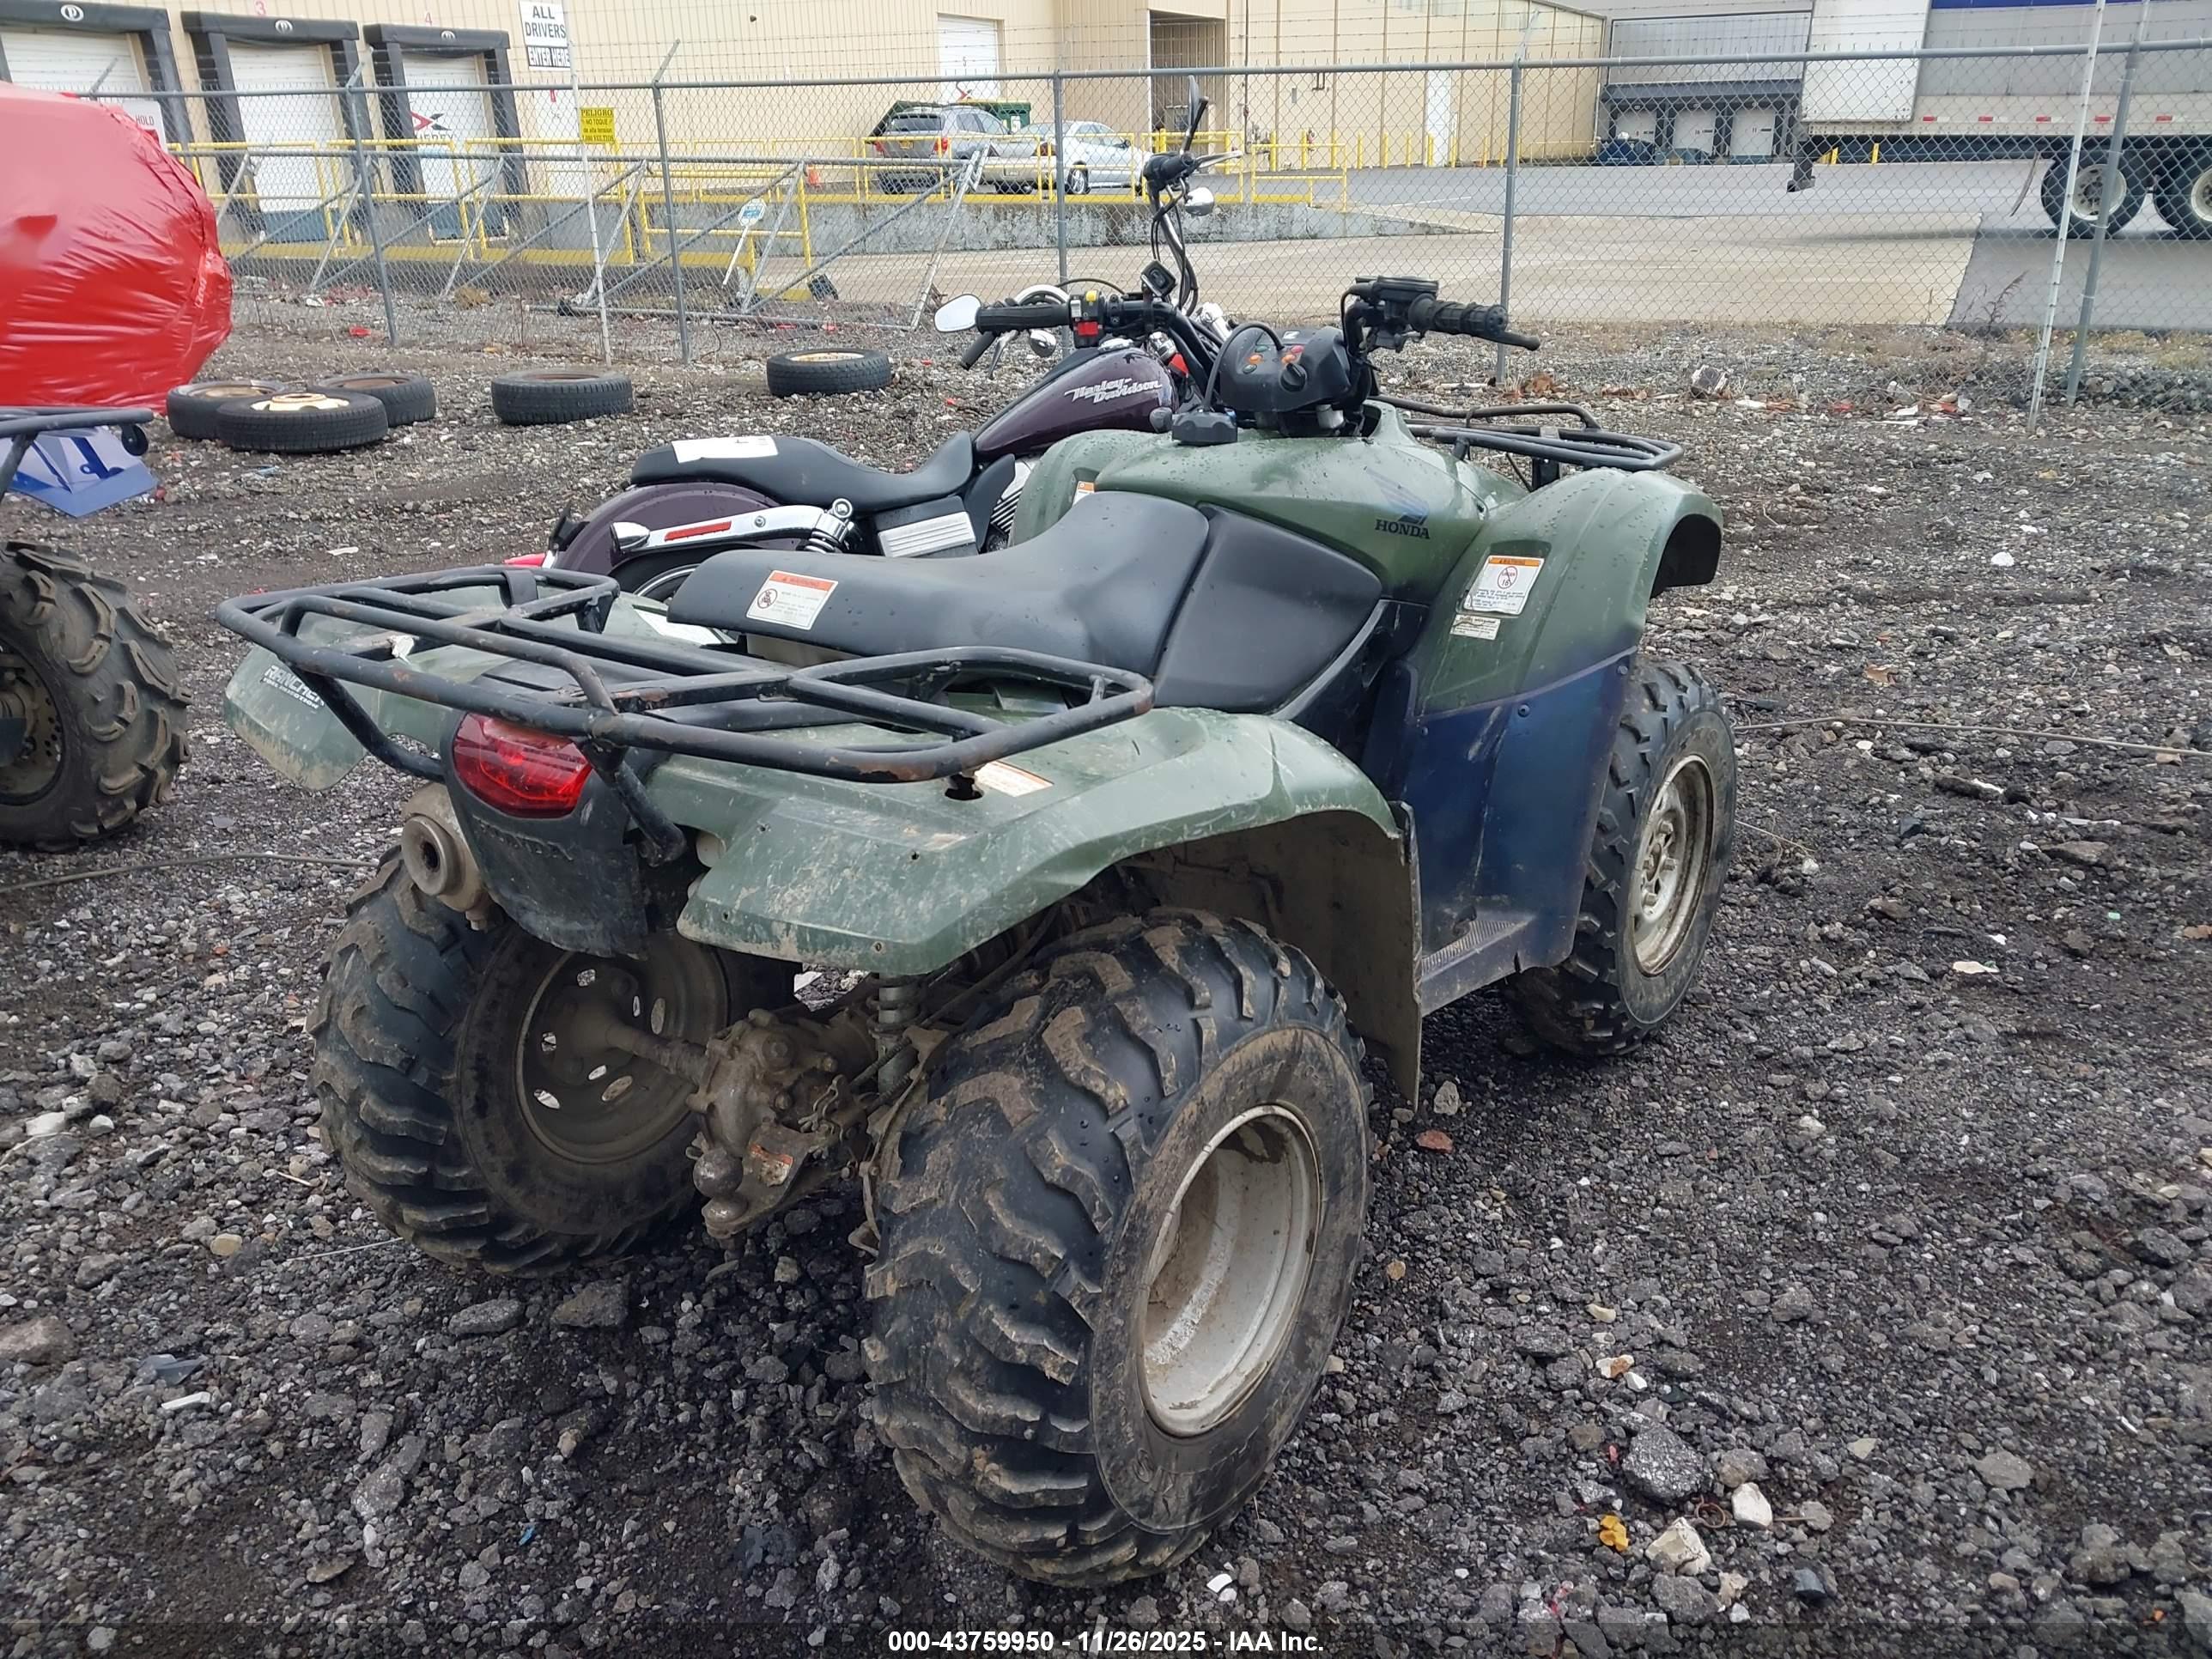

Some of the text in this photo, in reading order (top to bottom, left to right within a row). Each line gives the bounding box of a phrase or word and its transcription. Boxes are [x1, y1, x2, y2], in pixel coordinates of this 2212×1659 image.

[532, 5, 556, 20] ALL
[525, 21, 567, 39] DRIVERS
[528, 46, 571, 67] ENTER HERE
[580, 108, 614, 118] PELIGRO
[1085, 380, 1163, 404] Davidson
[1374, 519, 1431, 540] HONDA
